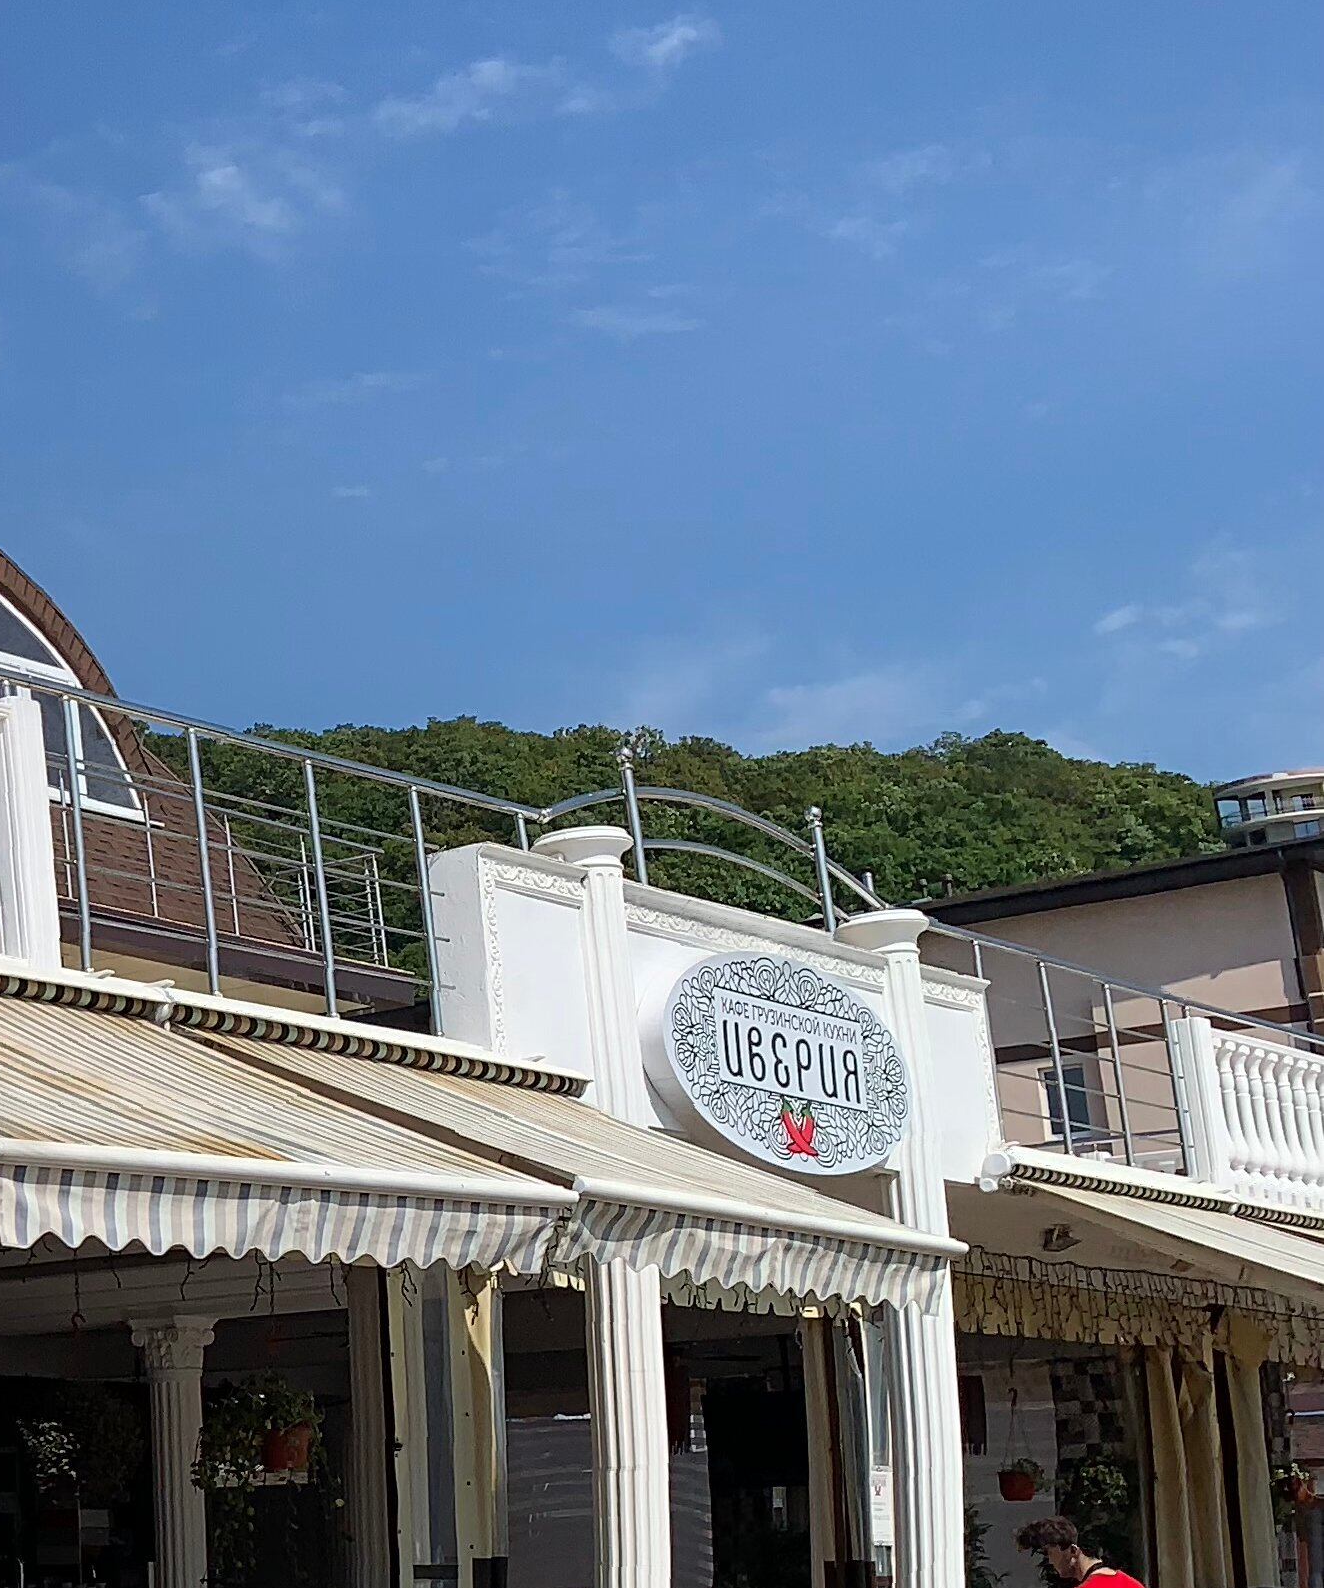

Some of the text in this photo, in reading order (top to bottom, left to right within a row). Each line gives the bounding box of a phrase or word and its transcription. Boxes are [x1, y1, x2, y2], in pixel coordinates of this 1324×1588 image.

[721, 996, 858, 1045] КАФЕ ГРУЗИНСКОЙ КУХНИ
